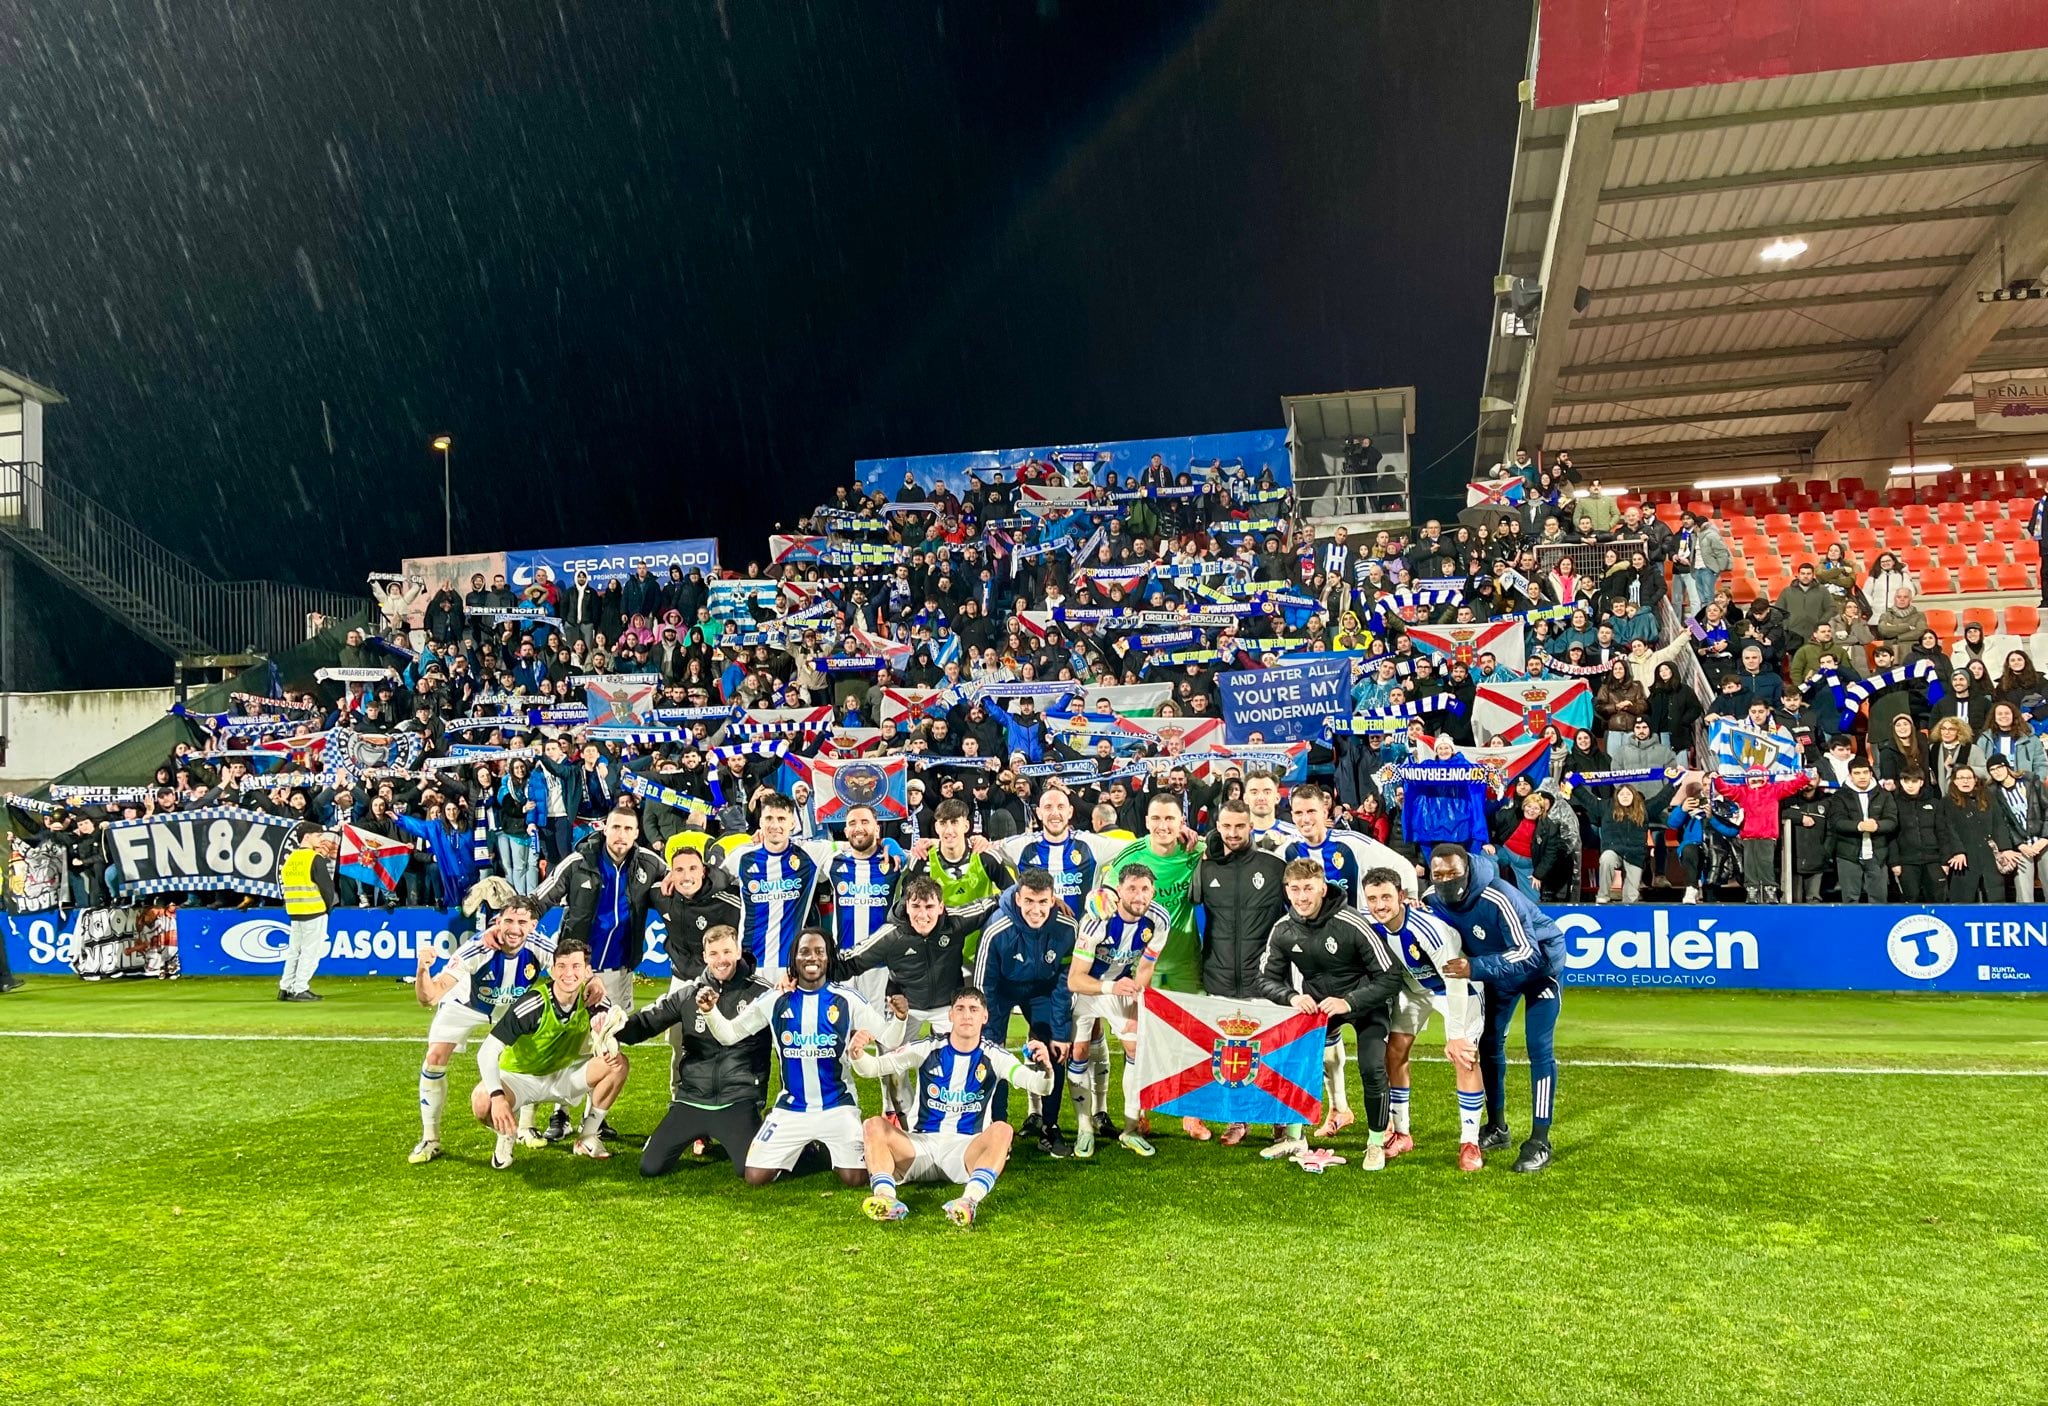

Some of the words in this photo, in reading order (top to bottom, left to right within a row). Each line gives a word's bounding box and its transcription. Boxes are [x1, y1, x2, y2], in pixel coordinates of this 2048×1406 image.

[1987, 384, 2029, 398] PEÑA
[563, 558, 625, 573] CESAR
[629, 552, 709, 567] DORADO
[1230, 672, 1257, 687] AND
[1262, 669, 1302, 683] AFTER
[1233, 685, 1301, 706] YOU'RE
[1311, 679, 1340, 697] MY
[1234, 705, 1344, 724] WONDERWALL
[113, 821, 199, 881] FN
[205, 819, 274, 880] 86
[751, 890, 801, 903] CRICURSA
[839, 897, 888, 907] CRICURSA
[1554, 909, 1760, 971] Galén
[1964, 921, 2048, 947] TERN
[1566, 973, 1627, 984] CENTRO
[1631, 974, 1716, 985] EDUCATIVO
[2002, 972, 2031, 980] GALICIA
[783, 1047, 836, 1059] CRICURSA
[928, 1098, 983, 1114] CRICURSA
